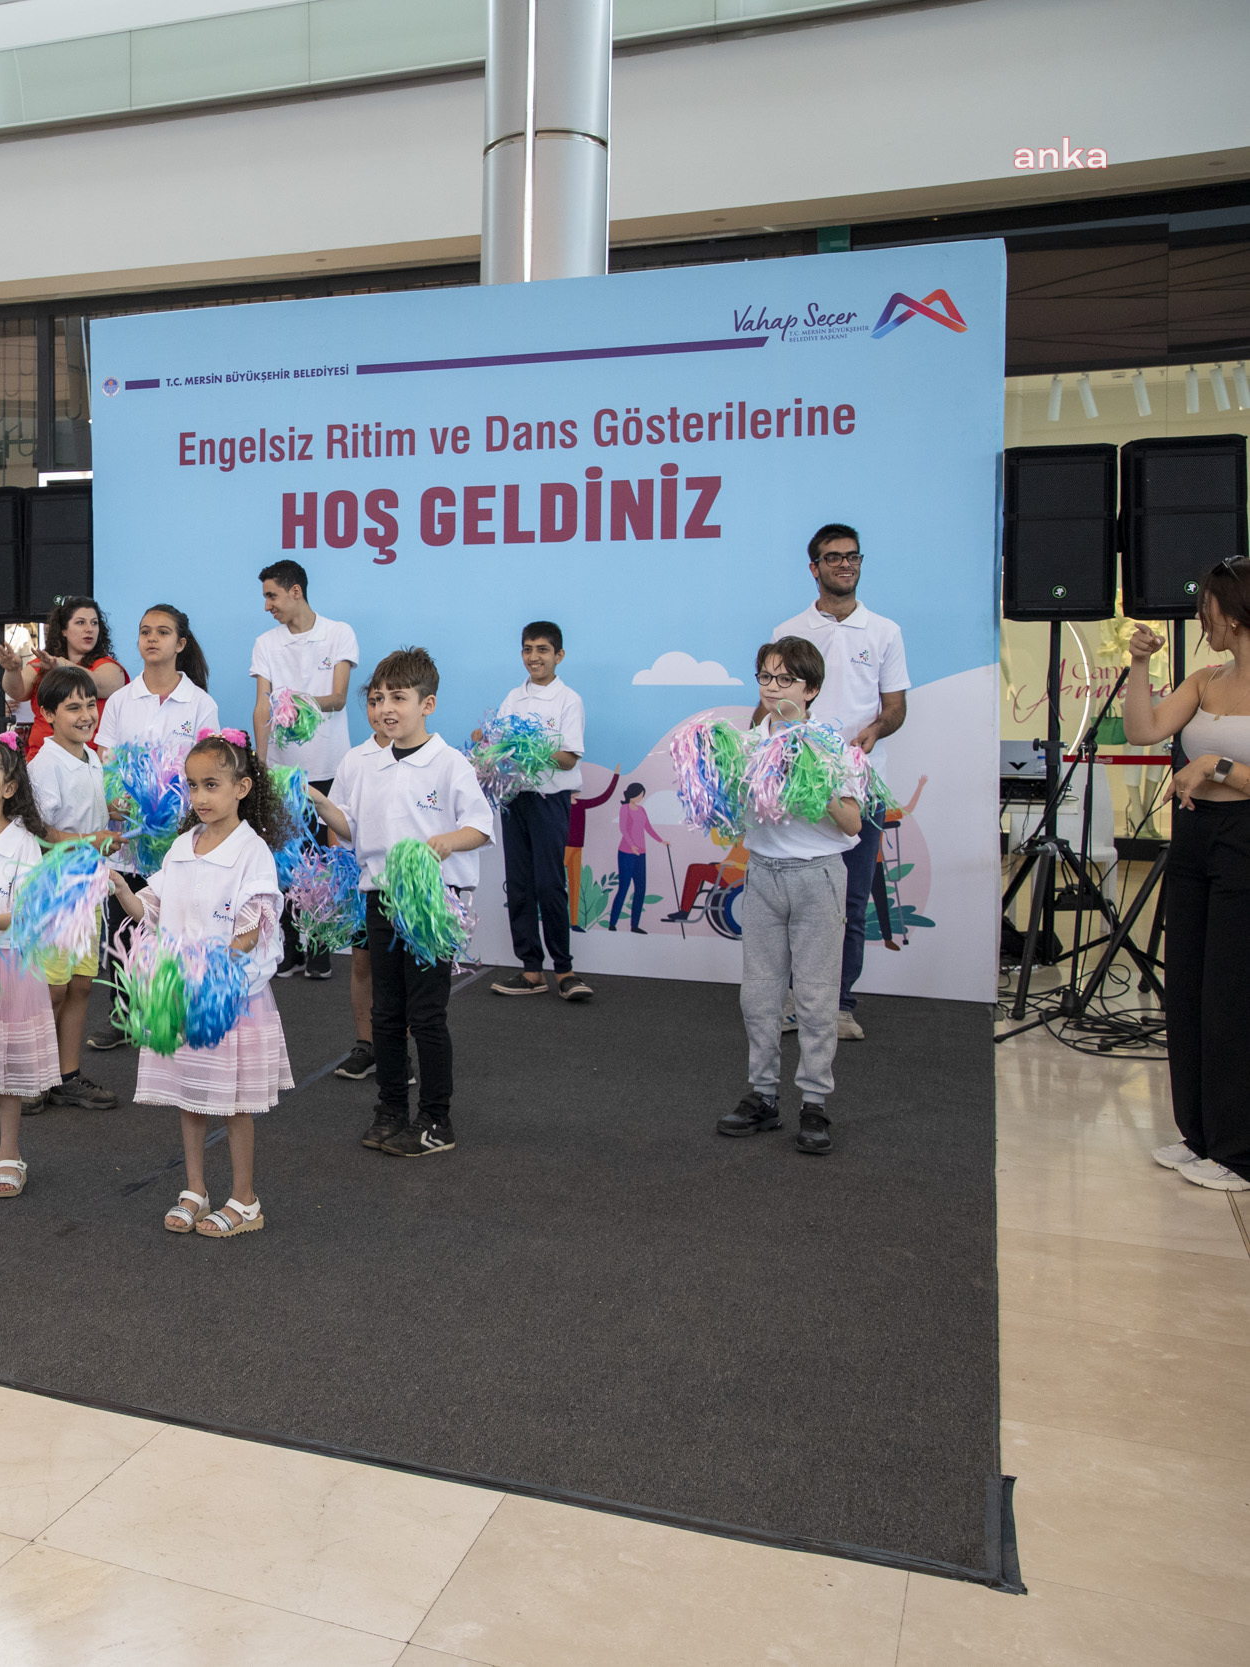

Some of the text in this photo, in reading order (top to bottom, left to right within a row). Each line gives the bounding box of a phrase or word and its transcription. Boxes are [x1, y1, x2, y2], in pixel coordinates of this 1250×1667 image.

[733, 302, 858, 342] Vahap Seçer
[788, 333, 848, 343] BELEDİYE BAŞKANI
[801, 327, 827, 336] MERSİN
[828, 325, 870, 334] BÜYÜKŞEHİR
[165, 363, 350, 387] T.C. MERSİN BÜYÜKŞEHİR BELEDİYESİ
[179, 397, 856, 472] Engelsiz Ritim ve Dans Gösterilerine
[281, 462, 722, 565] HOŞ GELDİNİZ
